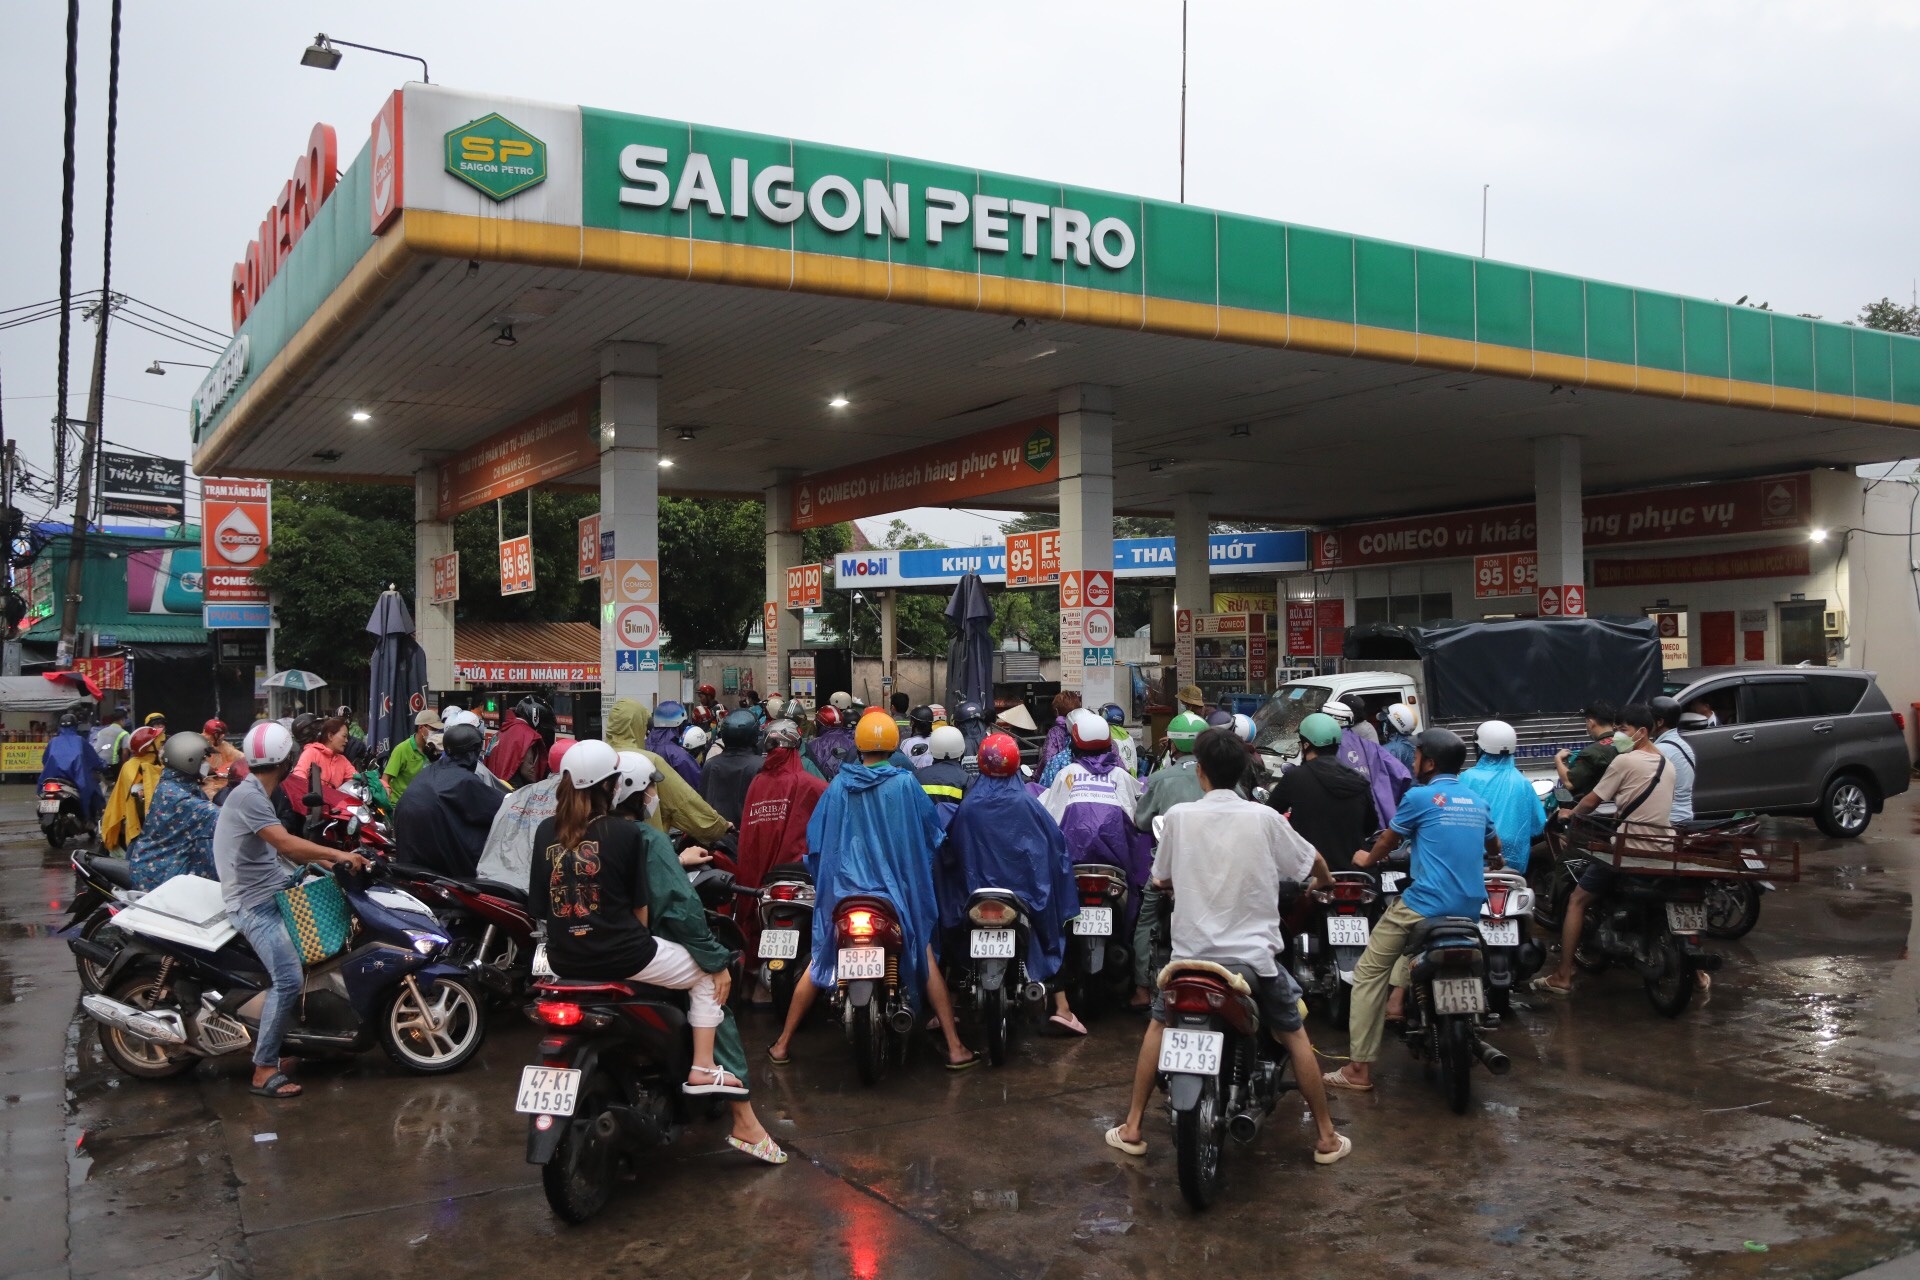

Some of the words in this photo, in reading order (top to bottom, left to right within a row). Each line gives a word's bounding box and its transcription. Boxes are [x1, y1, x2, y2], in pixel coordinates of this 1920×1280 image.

[462, 136, 533, 163] SP
[460, 162, 498, 173] SAIGON
[501, 166, 534, 175] PETRO
[619, 144, 909, 240] SAIGON
[925, 186, 1135, 270] PETRO
[1027, 437, 1051, 454] SP
[818, 478, 866, 505] COMECO
[883, 467, 921, 492] khách
[925, 460, 957, 482] hàng
[961, 450, 998, 480] phục
[1002, 447, 1021, 471] vụ
[205, 485, 227, 498] TRẠM
[229, 484, 250, 497] XĂNG
[251, 484, 267, 497] DẦU
[1627, 505, 1695, 534] phục
[1701, 502, 1735, 528] vụ
[220, 535, 261, 545] COMECO
[1014, 539, 1029, 549] RON
[1358, 526, 1449, 555] COMECO
[1456, 524, 1473, 545] vì
[582, 536, 594, 561] 95
[942, 556, 981, 572] KHU
[1131, 548, 1175, 563] THA
[1209, 539, 1256, 560] HỚT
[503, 556, 514, 579] 95
[518, 553, 529, 576] 95
[842, 558, 887, 577] Mobil
[1010, 549, 1033, 572] 95
[1041, 560, 1056, 569] RON
[1483, 559, 1499, 567] RON
[1517, 556, 1534, 564] RON
[213, 576, 262, 586] COMEC
[789, 572, 801, 588] DO
[805, 569, 819, 586] DO
[1479, 567, 1503, 586] 95
[1513, 565, 1538, 584] 95
[1228, 596, 1250, 611] RỬA
[1254, 600, 1269, 611] XE
[1290, 605, 1303, 619] RỬA
[1304, 608, 1313, 619] XE
[624, 619, 650, 635] 5Km/h
[1220, 620, 1245, 629] COMECO
[463, 664, 487, 680] RỬA
[490, 668, 505, 680] XE
[508, 668, 527, 680] CHI
[530, 666, 568, 680] NHÁNH
[571, 669, 583, 680] 22
[1080, 910, 1106, 921] 59-G2
[1075, 922, 1110, 934] 797.25
[1334, 920, 1362, 931] 59-G2
[1483, 920, 1511, 931] 59-S1
[766, 932, 793, 944] 59-S1
[978, 931, 1008, 943] 47-AB
[1332, 932, 1366, 944] 337.01
[760, 945, 795, 957] 661.09
[845, 950, 878, 963] 59-P2
[973, 944, 1012, 956] 490.24
[841, 963, 881, 978] 140.69
[1440, 979, 1475, 995] 71-FH
[1440, 996, 1478, 1012] 4153
[1171, 1032, 1214, 1051] 59-V2
[1163, 1051, 1217, 1071] 612.93
[530, 1071, 570, 1091] 47-K1
[521, 1091, 573, 1112] 415.95
